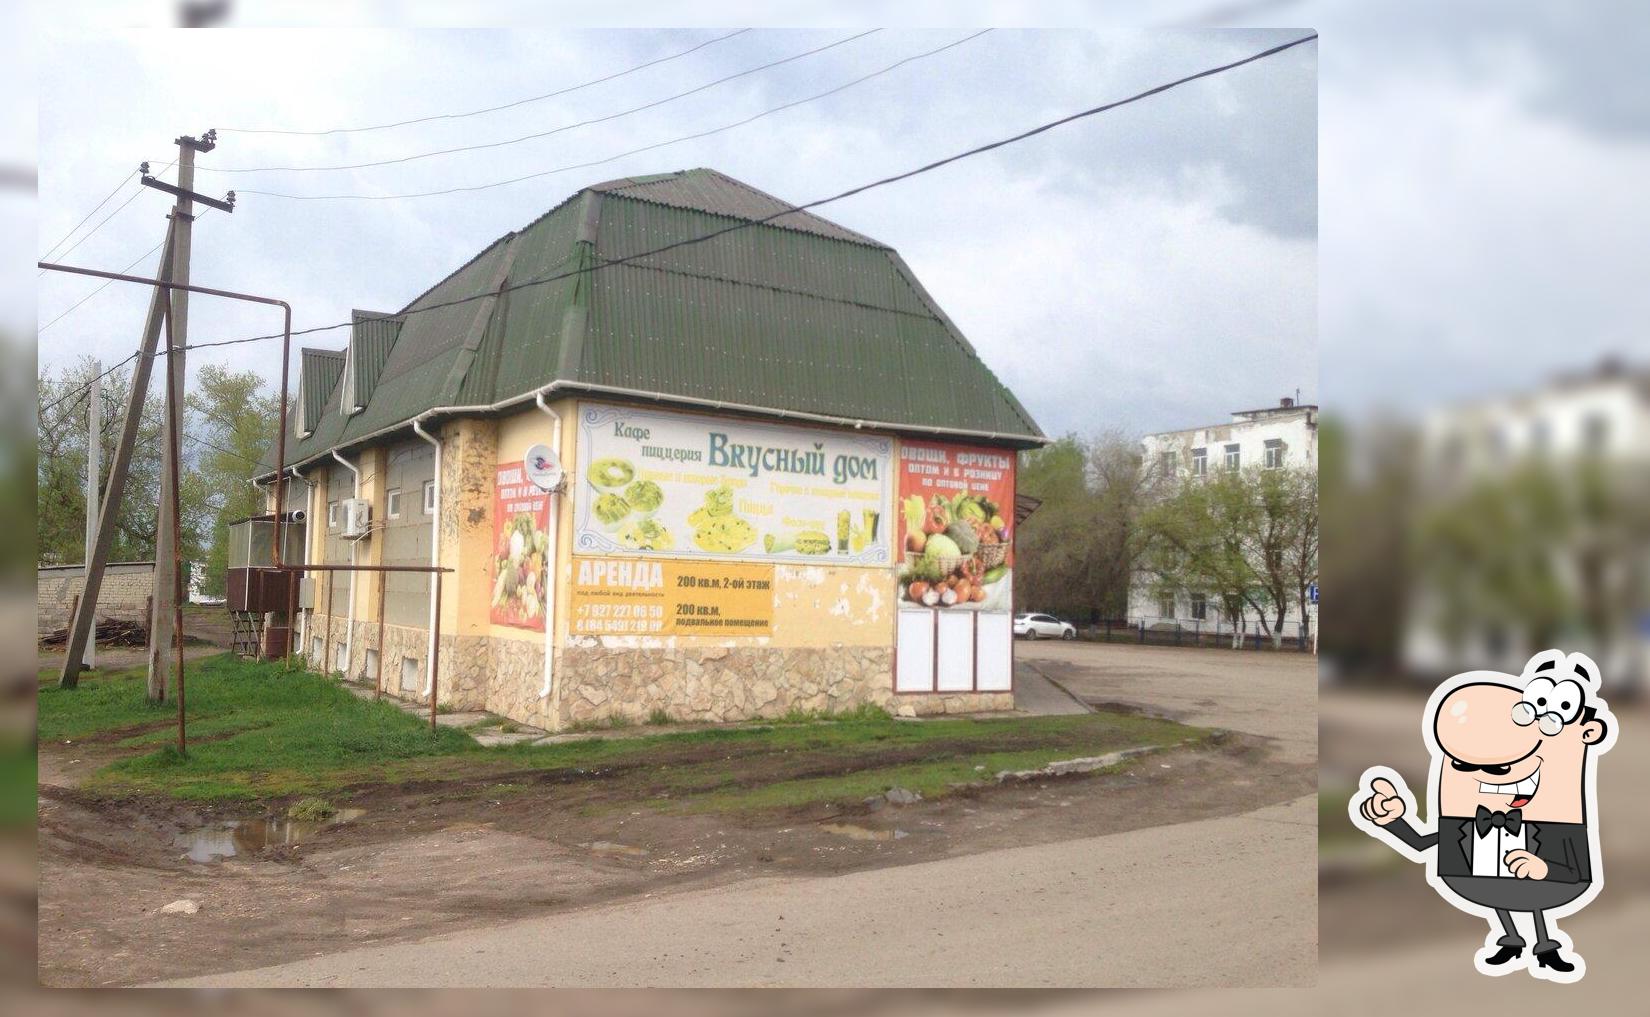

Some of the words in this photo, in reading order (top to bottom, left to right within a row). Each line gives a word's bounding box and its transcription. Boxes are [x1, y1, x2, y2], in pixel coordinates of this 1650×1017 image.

[613, 420, 651, 442] Кафе
[641, 444, 703, 463] пиццерия
[707, 431, 826, 478] Вкусный
[832, 453, 879, 485] дом
[956, 452, 1010, 470] ФРУКТЫ
[908, 463, 940, 475] ОПТОМ
[963, 468, 1003, 480] РОЗНИЦУ
[577, 559, 664, 591] АРЕНДА
[676, 575, 696, 588] 200
[723, 577, 745, 589] 2-ой
[745, 580, 770, 591] этаж
[676, 603, 695, 616] 200
[675, 617, 723, 628] подвальное
[724, 618, 769, 628] помещение
